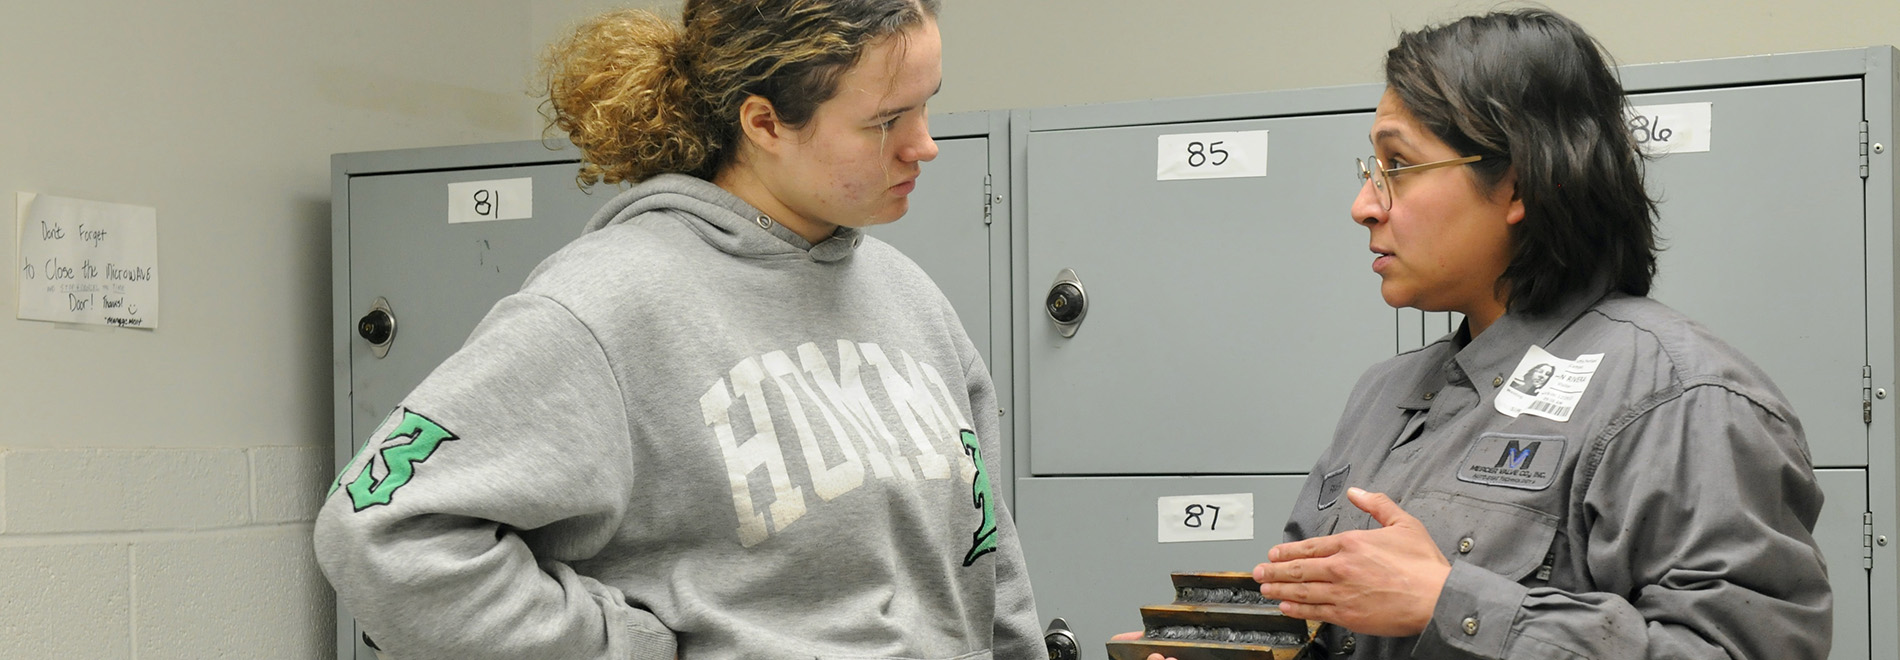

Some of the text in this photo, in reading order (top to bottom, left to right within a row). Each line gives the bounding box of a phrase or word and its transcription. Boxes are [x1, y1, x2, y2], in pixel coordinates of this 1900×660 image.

[1628, 115, 1673, 143] 86
[1187, 140, 1229, 168] 85
[473, 189, 499, 219] 81
[79, 224, 107, 247] Forget
[23, 256, 35, 280] to
[45, 258, 74, 280] Close
[81, 259, 99, 281] the
[1183, 503, 1221, 530] 87
